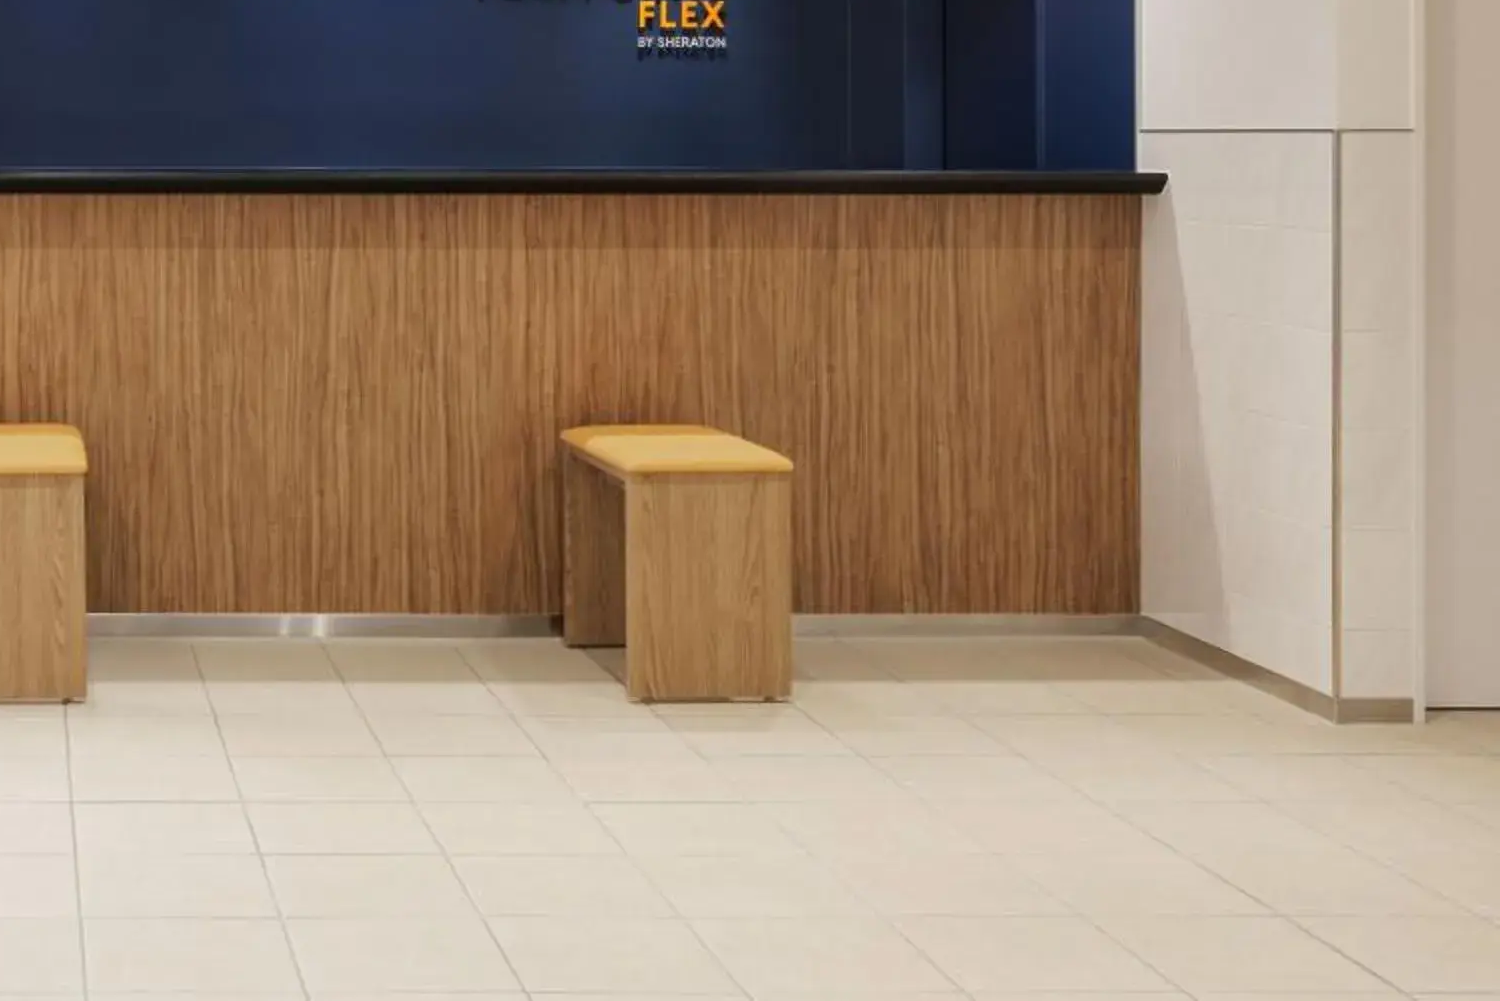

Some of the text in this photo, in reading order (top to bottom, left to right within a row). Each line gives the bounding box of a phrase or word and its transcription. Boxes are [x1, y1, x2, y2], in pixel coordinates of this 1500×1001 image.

[637, 0, 725, 29] FLEX
[637, 36, 727, 48] BY SHERATON
